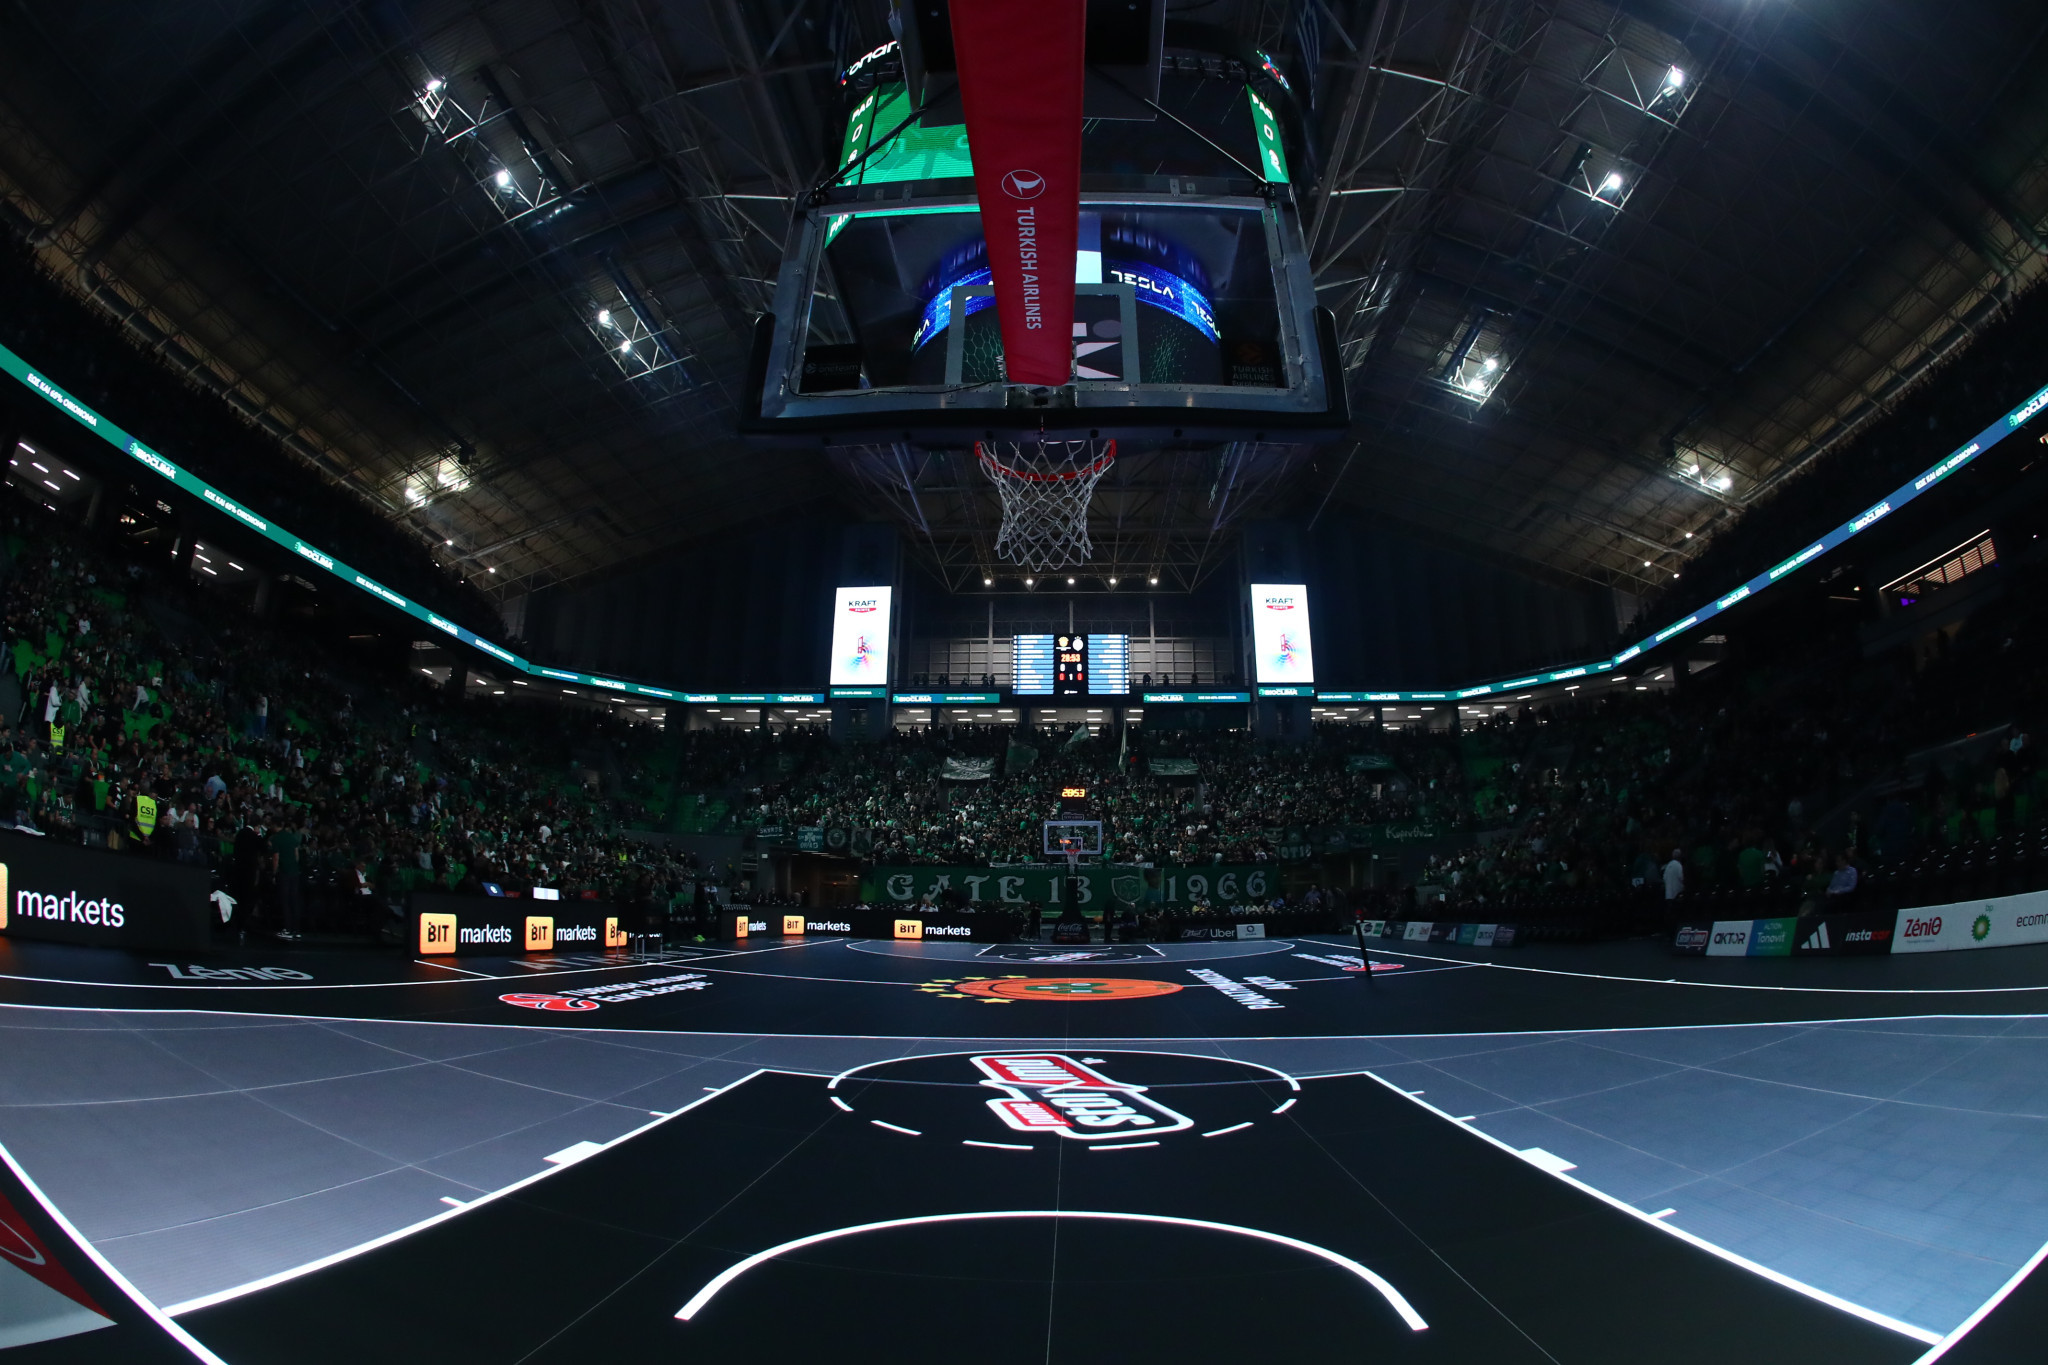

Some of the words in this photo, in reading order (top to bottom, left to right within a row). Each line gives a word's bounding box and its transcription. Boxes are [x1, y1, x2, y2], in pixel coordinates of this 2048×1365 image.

[1017, 206, 1038, 270] TURKISH
[1022, 273, 1042, 330] AIRLINES
[136, 448, 177, 479] BIOCLIMA
[1855, 501, 1891, 531] BIOCLIMA
[848, 599, 877, 607] KRAFT
[1265, 597, 1294, 605] KRAFT
[140, 805, 154, 816] CSI
[886, 873, 1025, 903] GATE
[1048, 875, 1093, 904] 13
[1166, 871, 1268, 903] 1966
[17, 890, 125, 928] markets
[1985, 904, 1994, 912] bp
[427, 921, 449, 943] BIT
[460, 923, 512, 944] markets
[531, 923, 548, 941] BIT
[556, 924, 597, 942] markets
[786, 918, 799, 930] BIT
[806, 920, 851, 933] markets
[899, 923, 916, 934] BIT
[925, 924, 971, 937] markets
[1210, 929, 1236, 939] Uber
[1845, 928, 1892, 942] instacar
